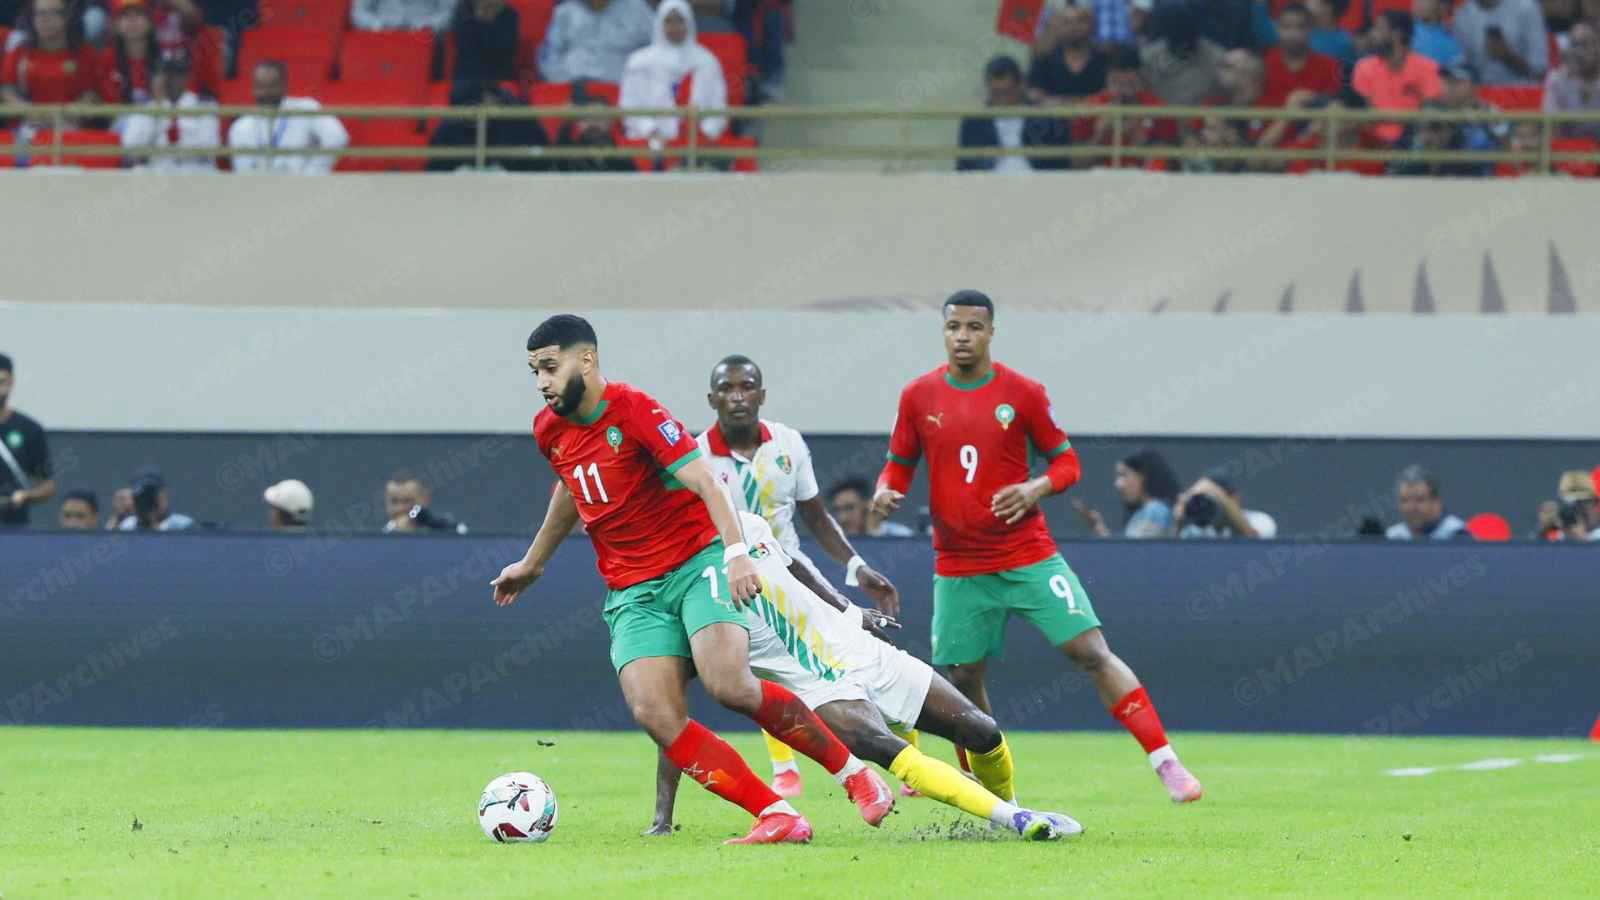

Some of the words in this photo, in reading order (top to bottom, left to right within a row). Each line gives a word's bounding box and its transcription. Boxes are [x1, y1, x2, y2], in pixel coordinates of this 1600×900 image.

[573, 463, 608, 504] 11
[960, 445, 979, 484] 9
[1049, 574, 1075, 610] 9
